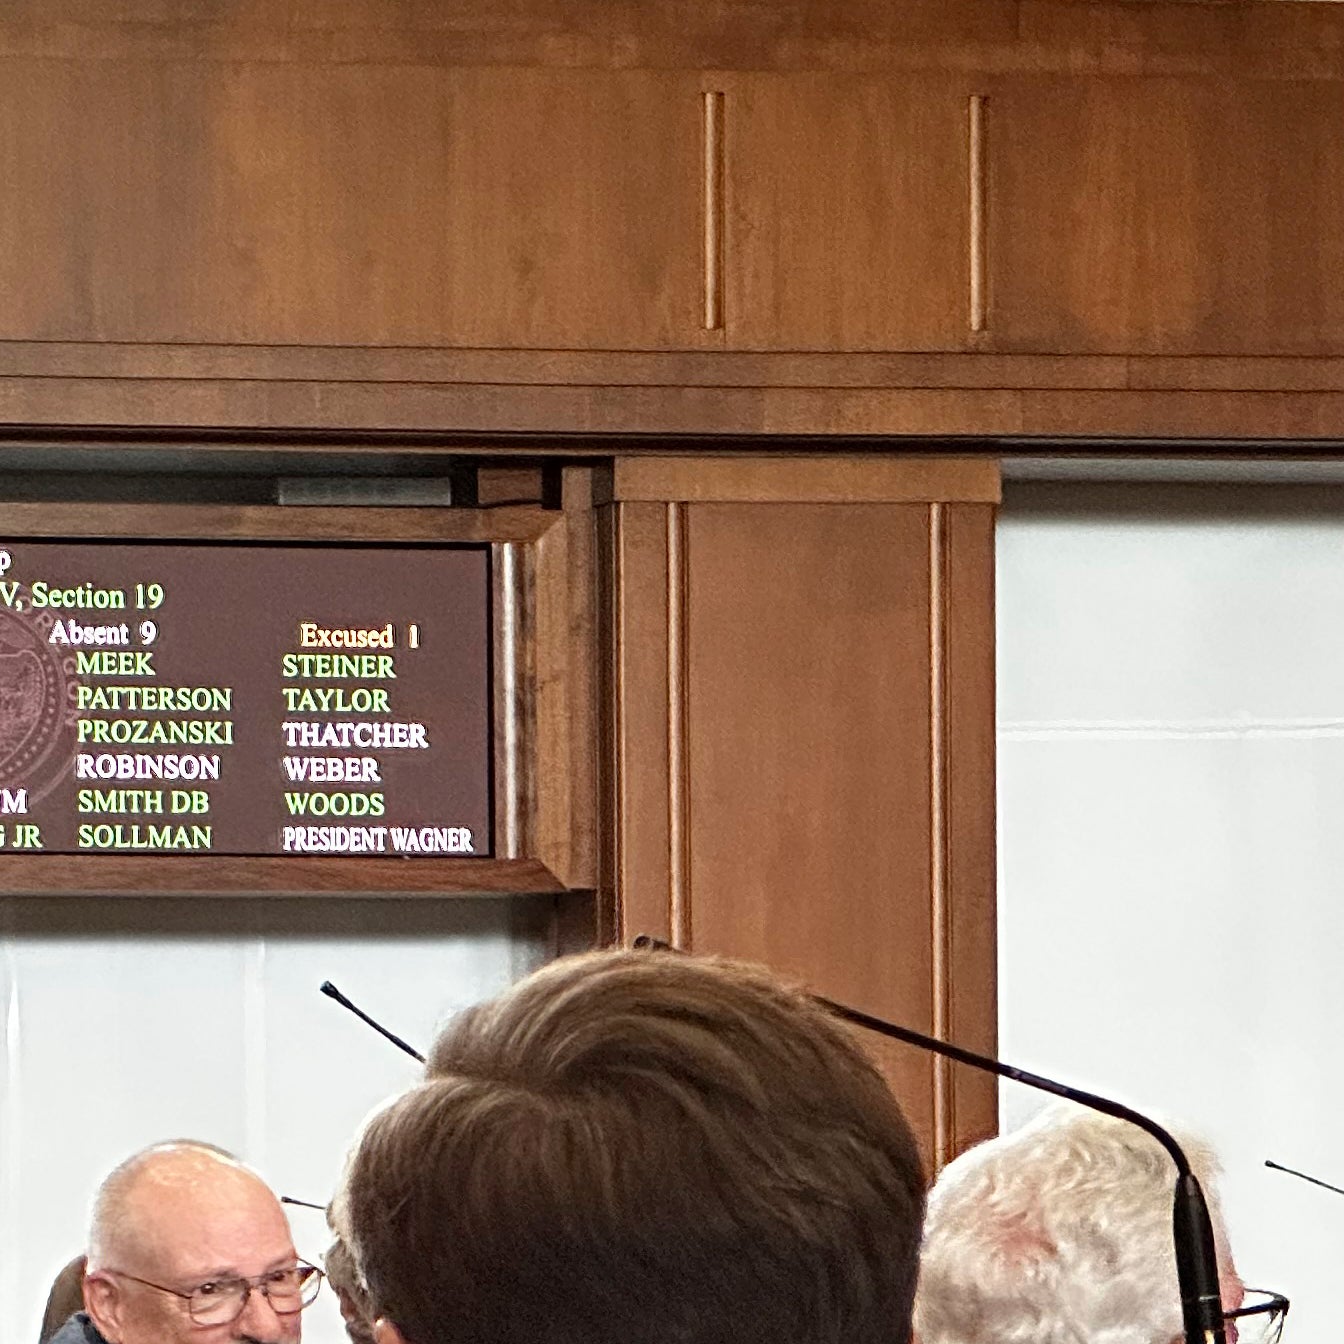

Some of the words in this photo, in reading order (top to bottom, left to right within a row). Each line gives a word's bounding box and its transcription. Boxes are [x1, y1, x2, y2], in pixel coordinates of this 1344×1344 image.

[31, 582, 125, 608] Section
[136, 583, 164, 610] 19
[47, 618, 129, 646] Absent
[138, 620, 158, 646] 9
[300, 623, 394, 650] Excused
[408, 624, 420, 649] 1
[74, 651, 156, 676] MEEK
[282, 653, 398, 679] STEINER
[75, 684, 232, 711] PATTERSON
[282, 688, 392, 713] TAYLOR
[76, 719, 234, 745] PROZANSKI
[281, 721, 430, 749] THATCHER
[75, 754, 221, 780] ROBINSON
[282, 756, 382, 782] WEBER
[78, 789, 163, 814] SMITH
[171, 790, 209, 814] DB
[284, 792, 386, 817] WOODS
[12, 824, 43, 849] JR
[78, 824, 213, 850] SOLLMAN
[282, 826, 387, 852] PRESIDENT
[391, 827, 475, 853] WAGNER
